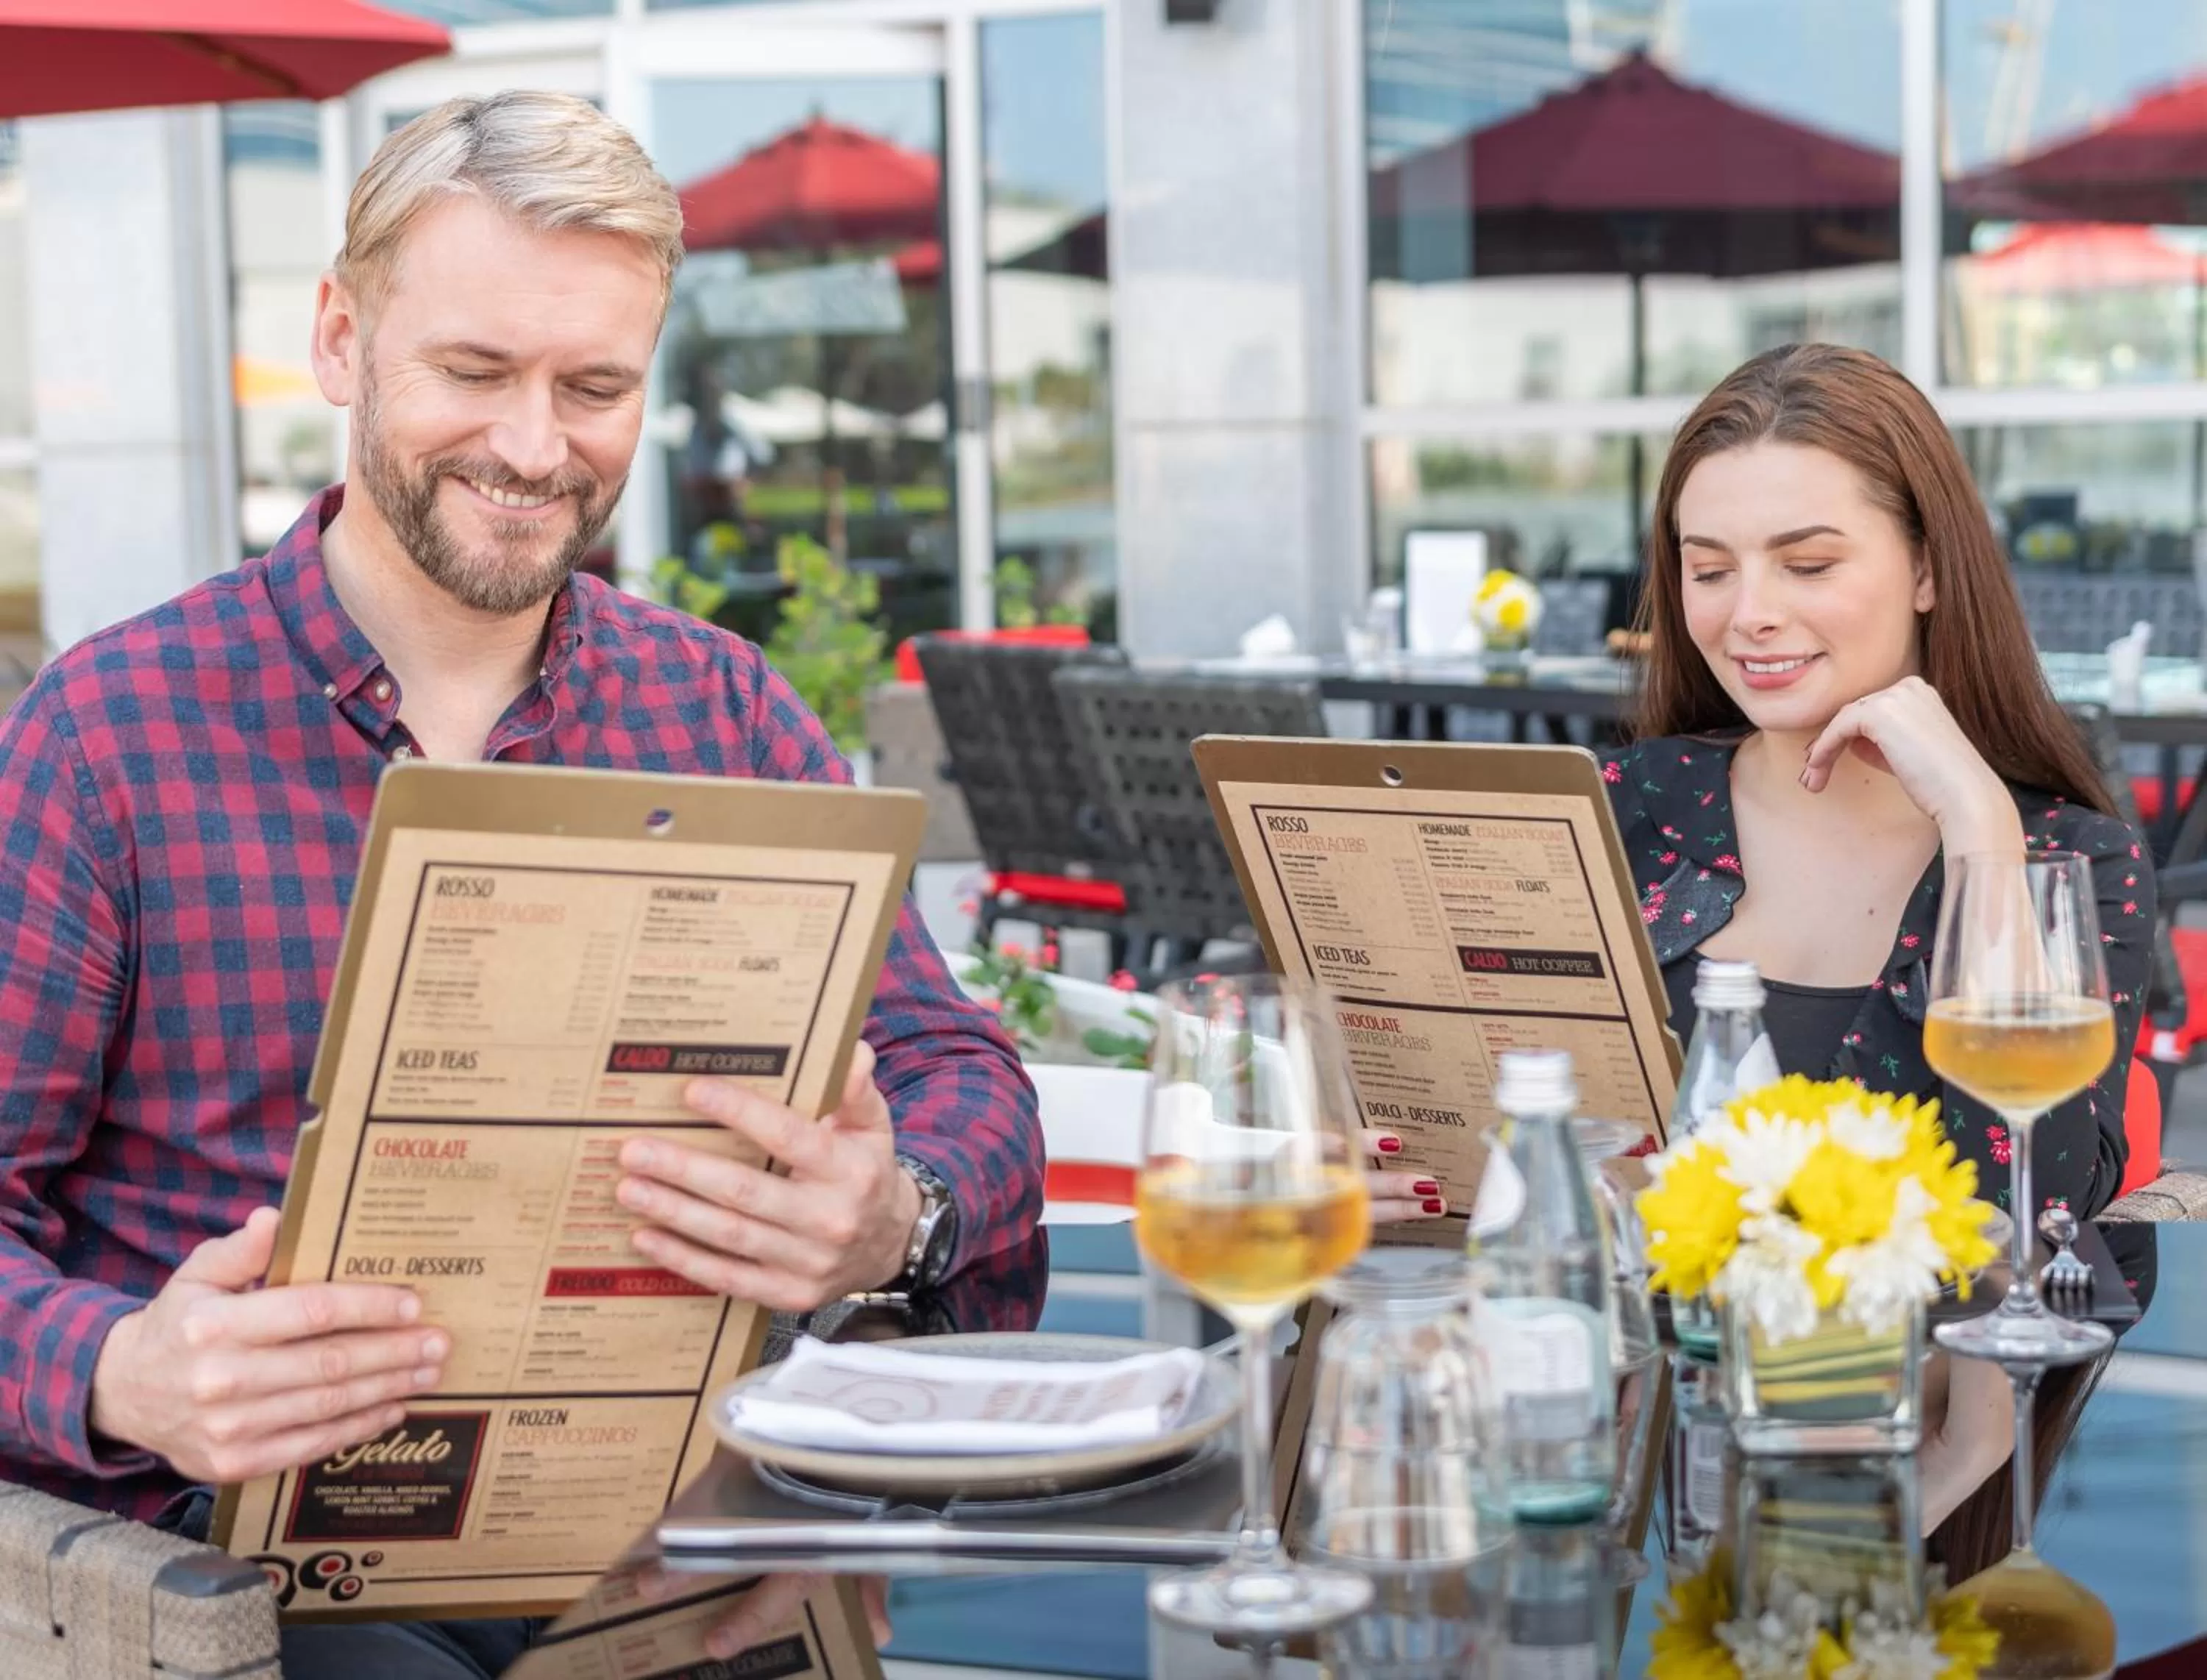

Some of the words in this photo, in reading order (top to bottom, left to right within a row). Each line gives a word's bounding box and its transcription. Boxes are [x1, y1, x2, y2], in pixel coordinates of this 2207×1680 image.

[1266, 816, 1309, 833] ROSSO
[1417, 823, 1471, 837] HOMEMADE
[1273, 834, 1368, 853] BEVERAGES
[435, 875, 495, 898] ROSSO
[1515, 879, 1551, 894] FLOATS
[1312, 944, 1340, 962] ICED
[1341, 947, 1371, 966] TEAS
[1464, 949, 1507, 969] CALDO
[1511, 956, 1539, 972] HOT
[1540, 958, 1595, 974] COFFEE
[1336, 1011, 1403, 1033] CHOCOLATE
[396, 1047, 436, 1069] ICED
[440, 1049, 480, 1070] TEAS
[613, 1044, 672, 1070] CALDO
[673, 1052, 712, 1071] HOT
[711, 1053, 778, 1071] COFFEE
[1365, 1101, 1402, 1119] DOLCI
[1408, 1106, 1466, 1128] DESSERTS
[373, 1138, 472, 1160] CHOCOLATE
[344, 1256, 396, 1276] DOLCI
[405, 1256, 486, 1276] DESSERTS
[508, 1408, 570, 1427] FROZEN
[502, 1425, 639, 1447] CAPPUCCINOS
